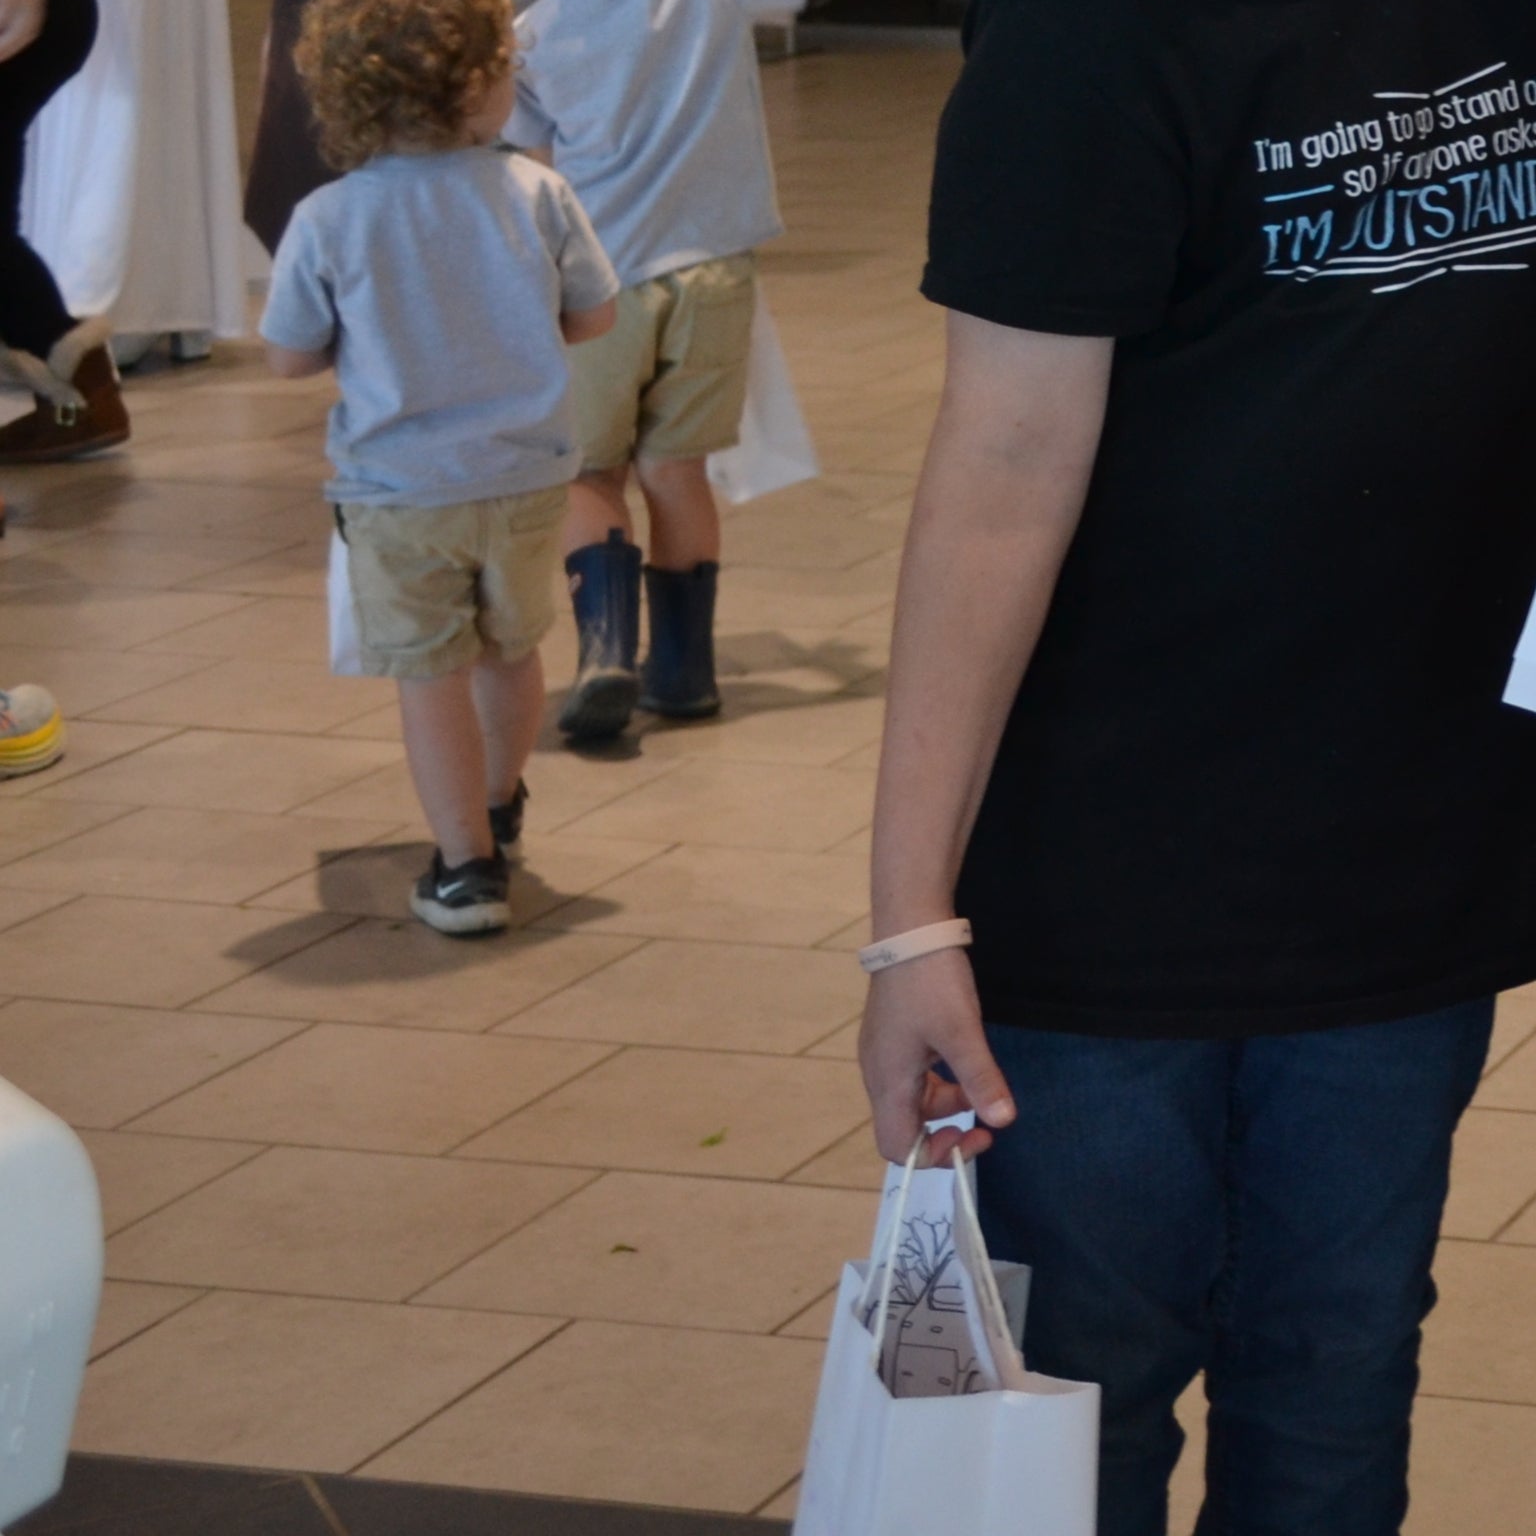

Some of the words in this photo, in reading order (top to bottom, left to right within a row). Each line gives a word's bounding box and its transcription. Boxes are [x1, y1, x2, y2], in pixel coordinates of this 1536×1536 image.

[1254, 138, 1294, 172] I'm
[1301, 120, 1383, 167] going
[1387, 111, 1414, 142] to
[1438, 79, 1520, 129] stand
[1343, 165, 1377, 197] so
[1263, 210, 1334, 265] I'M
